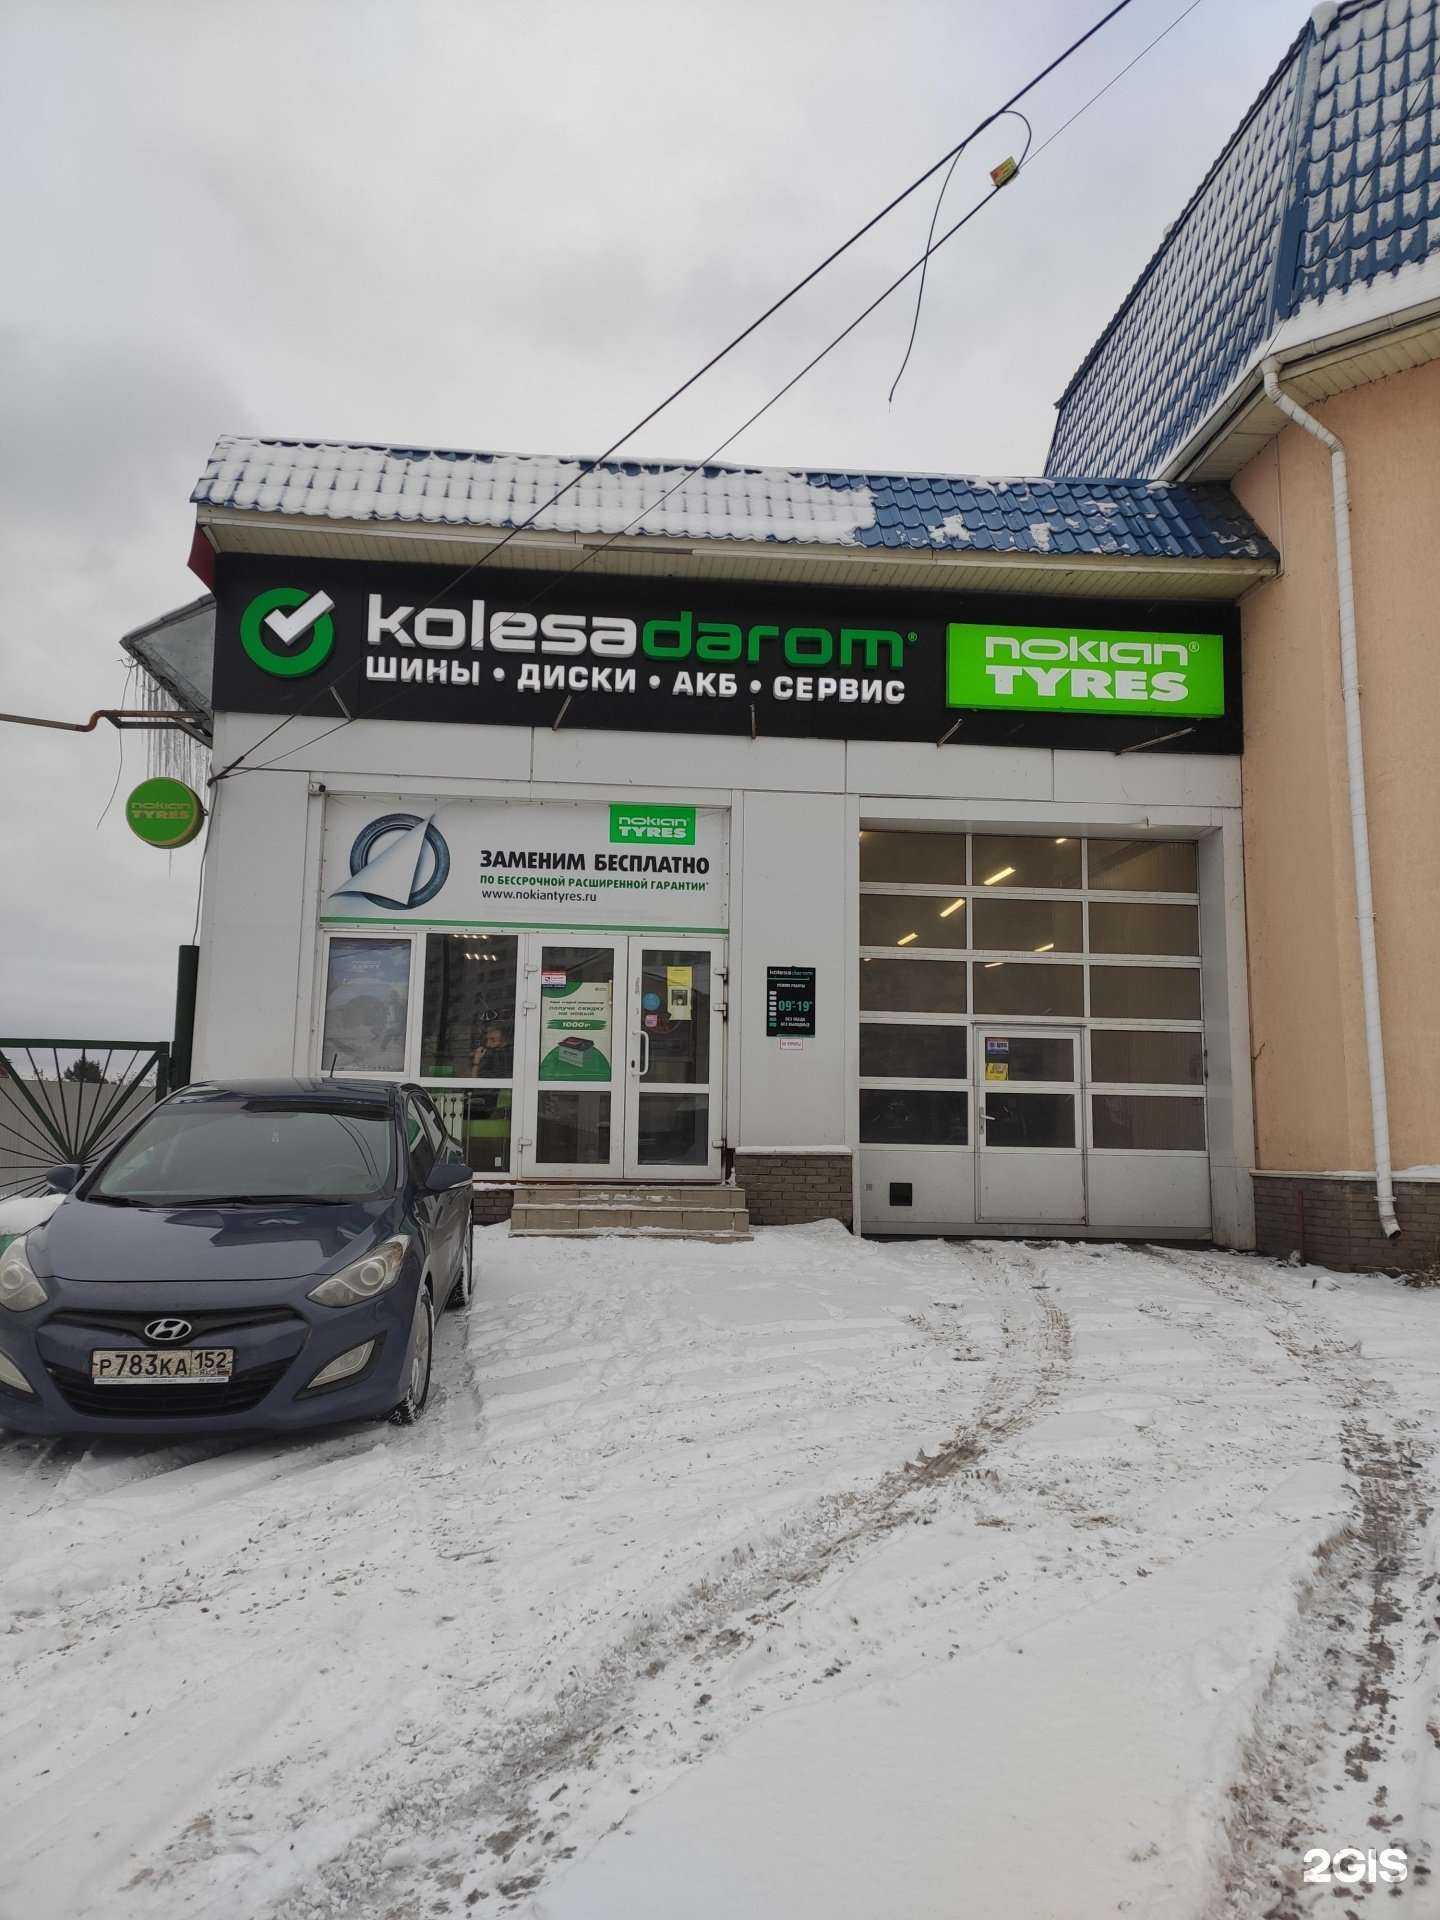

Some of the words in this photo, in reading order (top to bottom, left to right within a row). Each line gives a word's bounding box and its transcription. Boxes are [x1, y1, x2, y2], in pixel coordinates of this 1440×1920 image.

[366, 656, 480, 686] ШИНЫ
[517, 663, 636, 693] ДИСКИ
[672, 670, 738, 698] АКБ
[773, 676, 905, 704] СЕРВИС
[985, 665, 1189, 702] TYRES
[618, 826, 687, 839] TYRES
[480, 850, 586, 871] ЗАМЕНИМ
[594, 853, 710, 875] БЕСПЛАТНО
[480, 875, 495, 885] ПО
[497, 875, 566, 887] БЕССРОЧНОЙ
[568, 878, 648, 890] РАСШИРЕННОЙ
[481, 889, 597, 903] www.nokiantyres.ru
